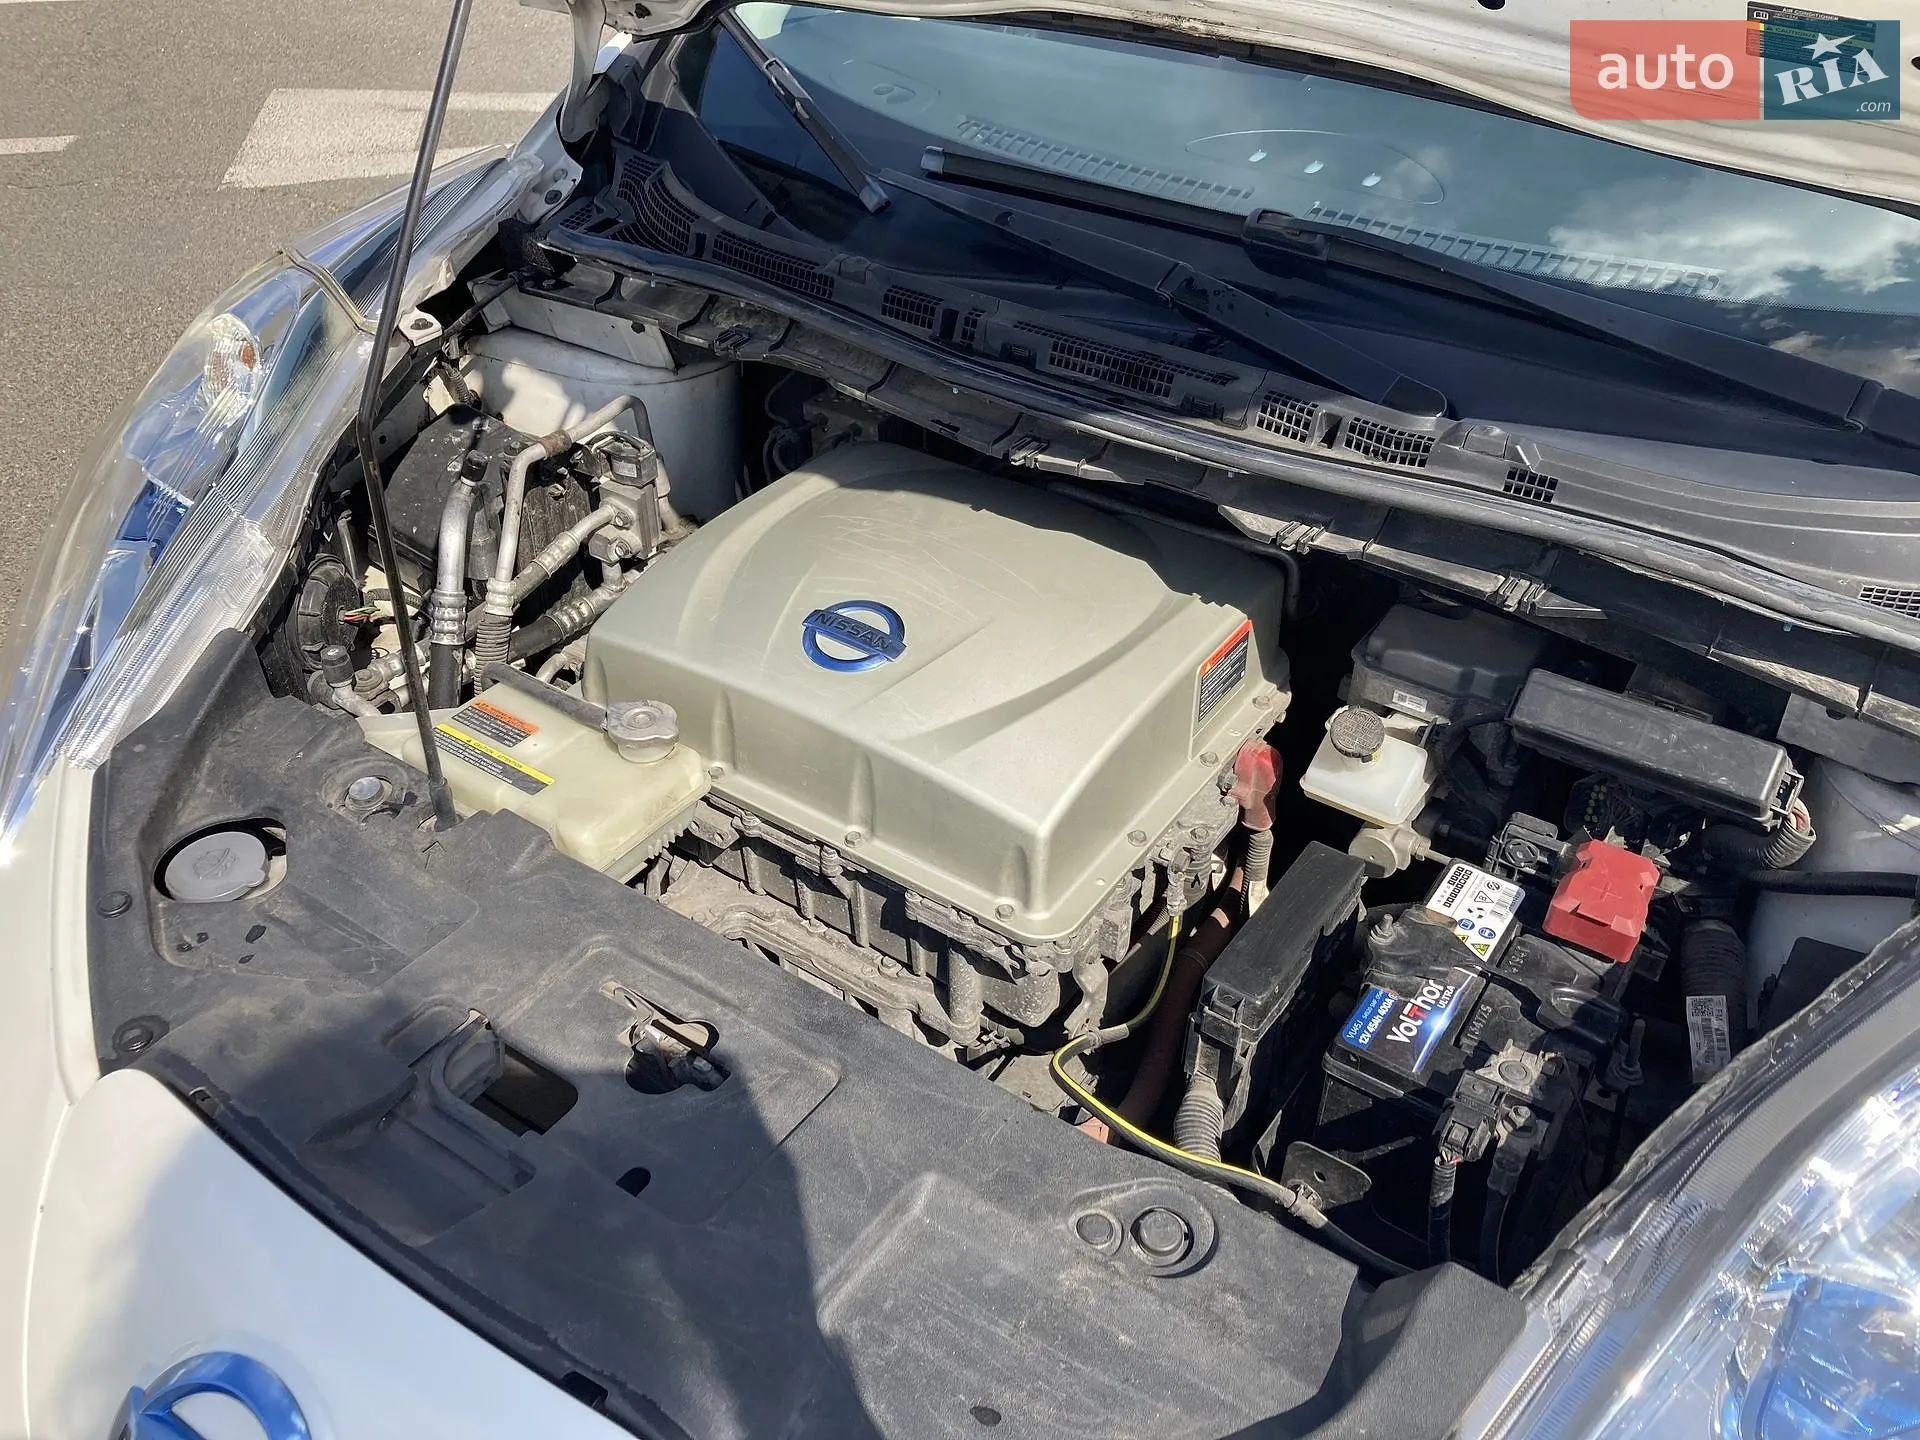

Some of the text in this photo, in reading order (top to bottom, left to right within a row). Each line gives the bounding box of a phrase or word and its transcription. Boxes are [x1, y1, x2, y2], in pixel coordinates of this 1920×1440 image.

[814, 613, 891, 650] NISSAN
[1437, 985, 1456, 1009] ULTRA
[1346, 1020, 1363, 1039] VU45J
[1359, 1030, 1371, 1044] 12V
[1367, 1015, 1383, 1033] 45Ah
[1378, 998, 1394, 1016] 400A
